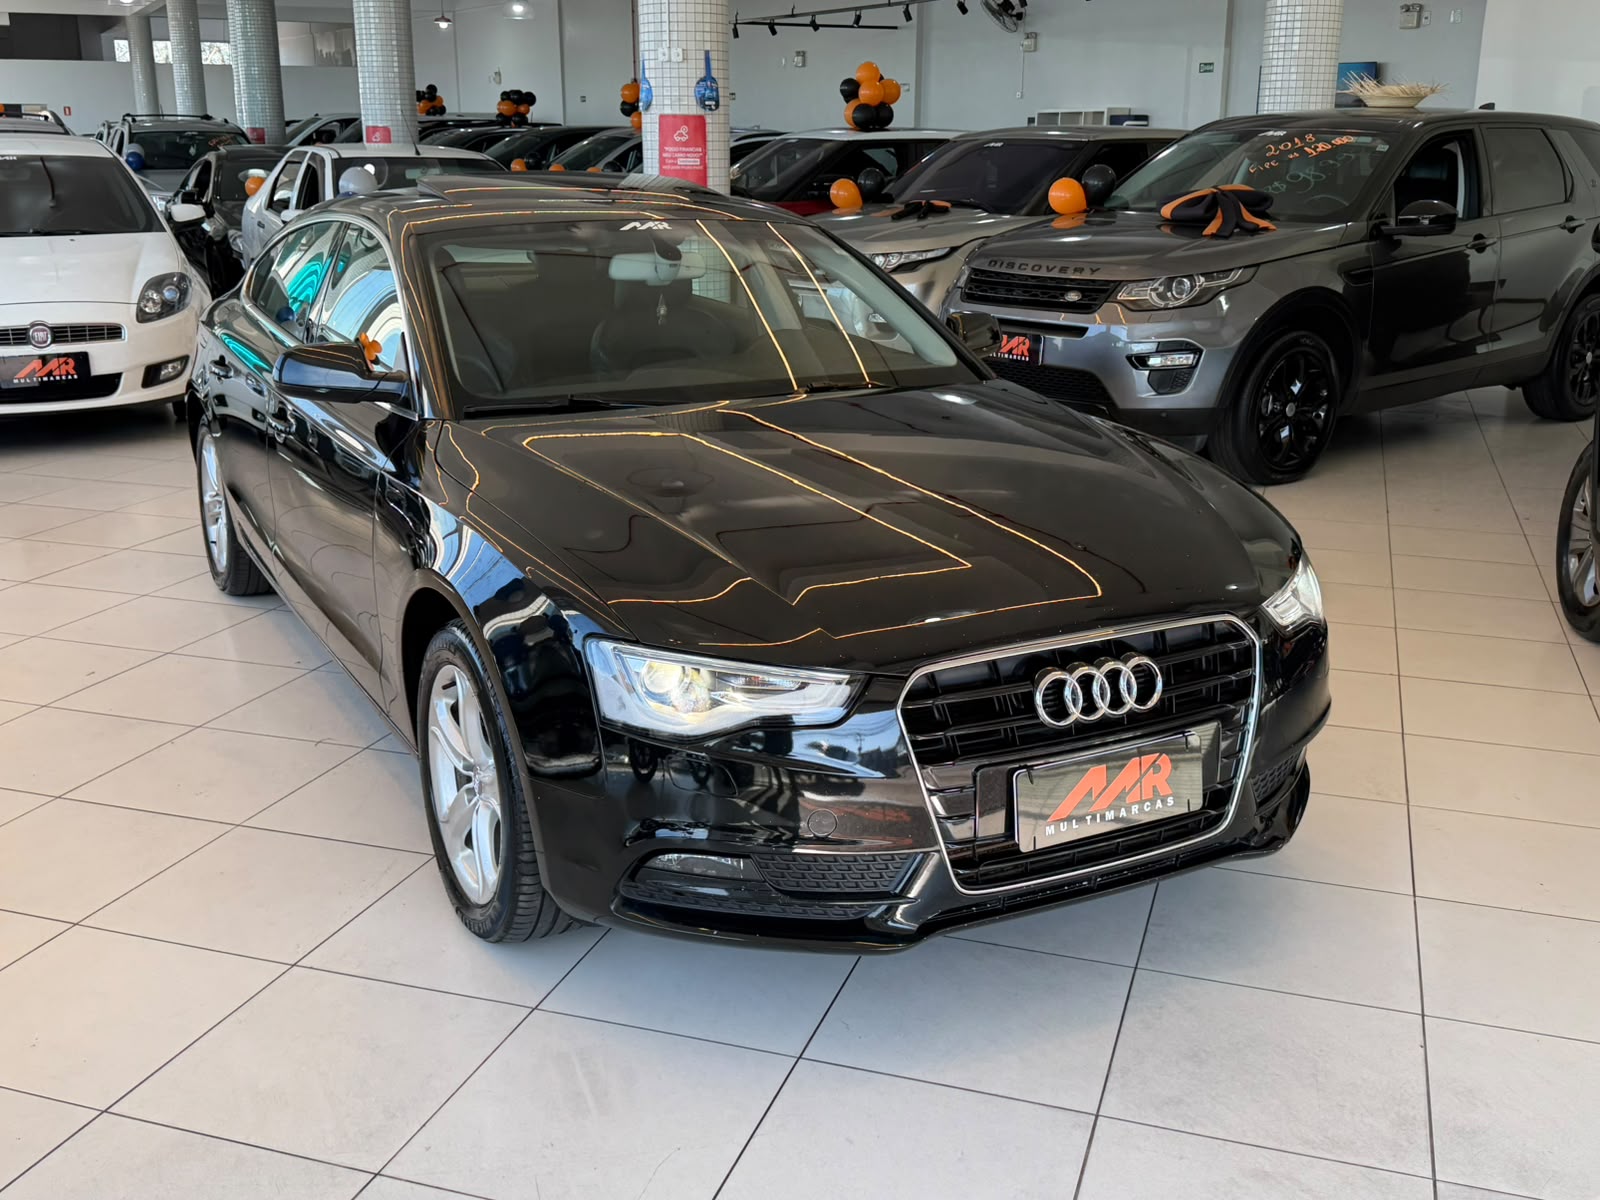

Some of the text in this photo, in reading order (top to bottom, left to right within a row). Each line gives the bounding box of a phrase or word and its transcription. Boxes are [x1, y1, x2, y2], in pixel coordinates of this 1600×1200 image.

[1265, 133, 1316, 157] 2018
[987, 259, 1101, 275] DISCOVERY
[32, 331, 47, 342] FIAT
[13, 375, 79, 384] MULTIMARCAS
[1045, 796, 1175, 837] MULTIMARCAS
